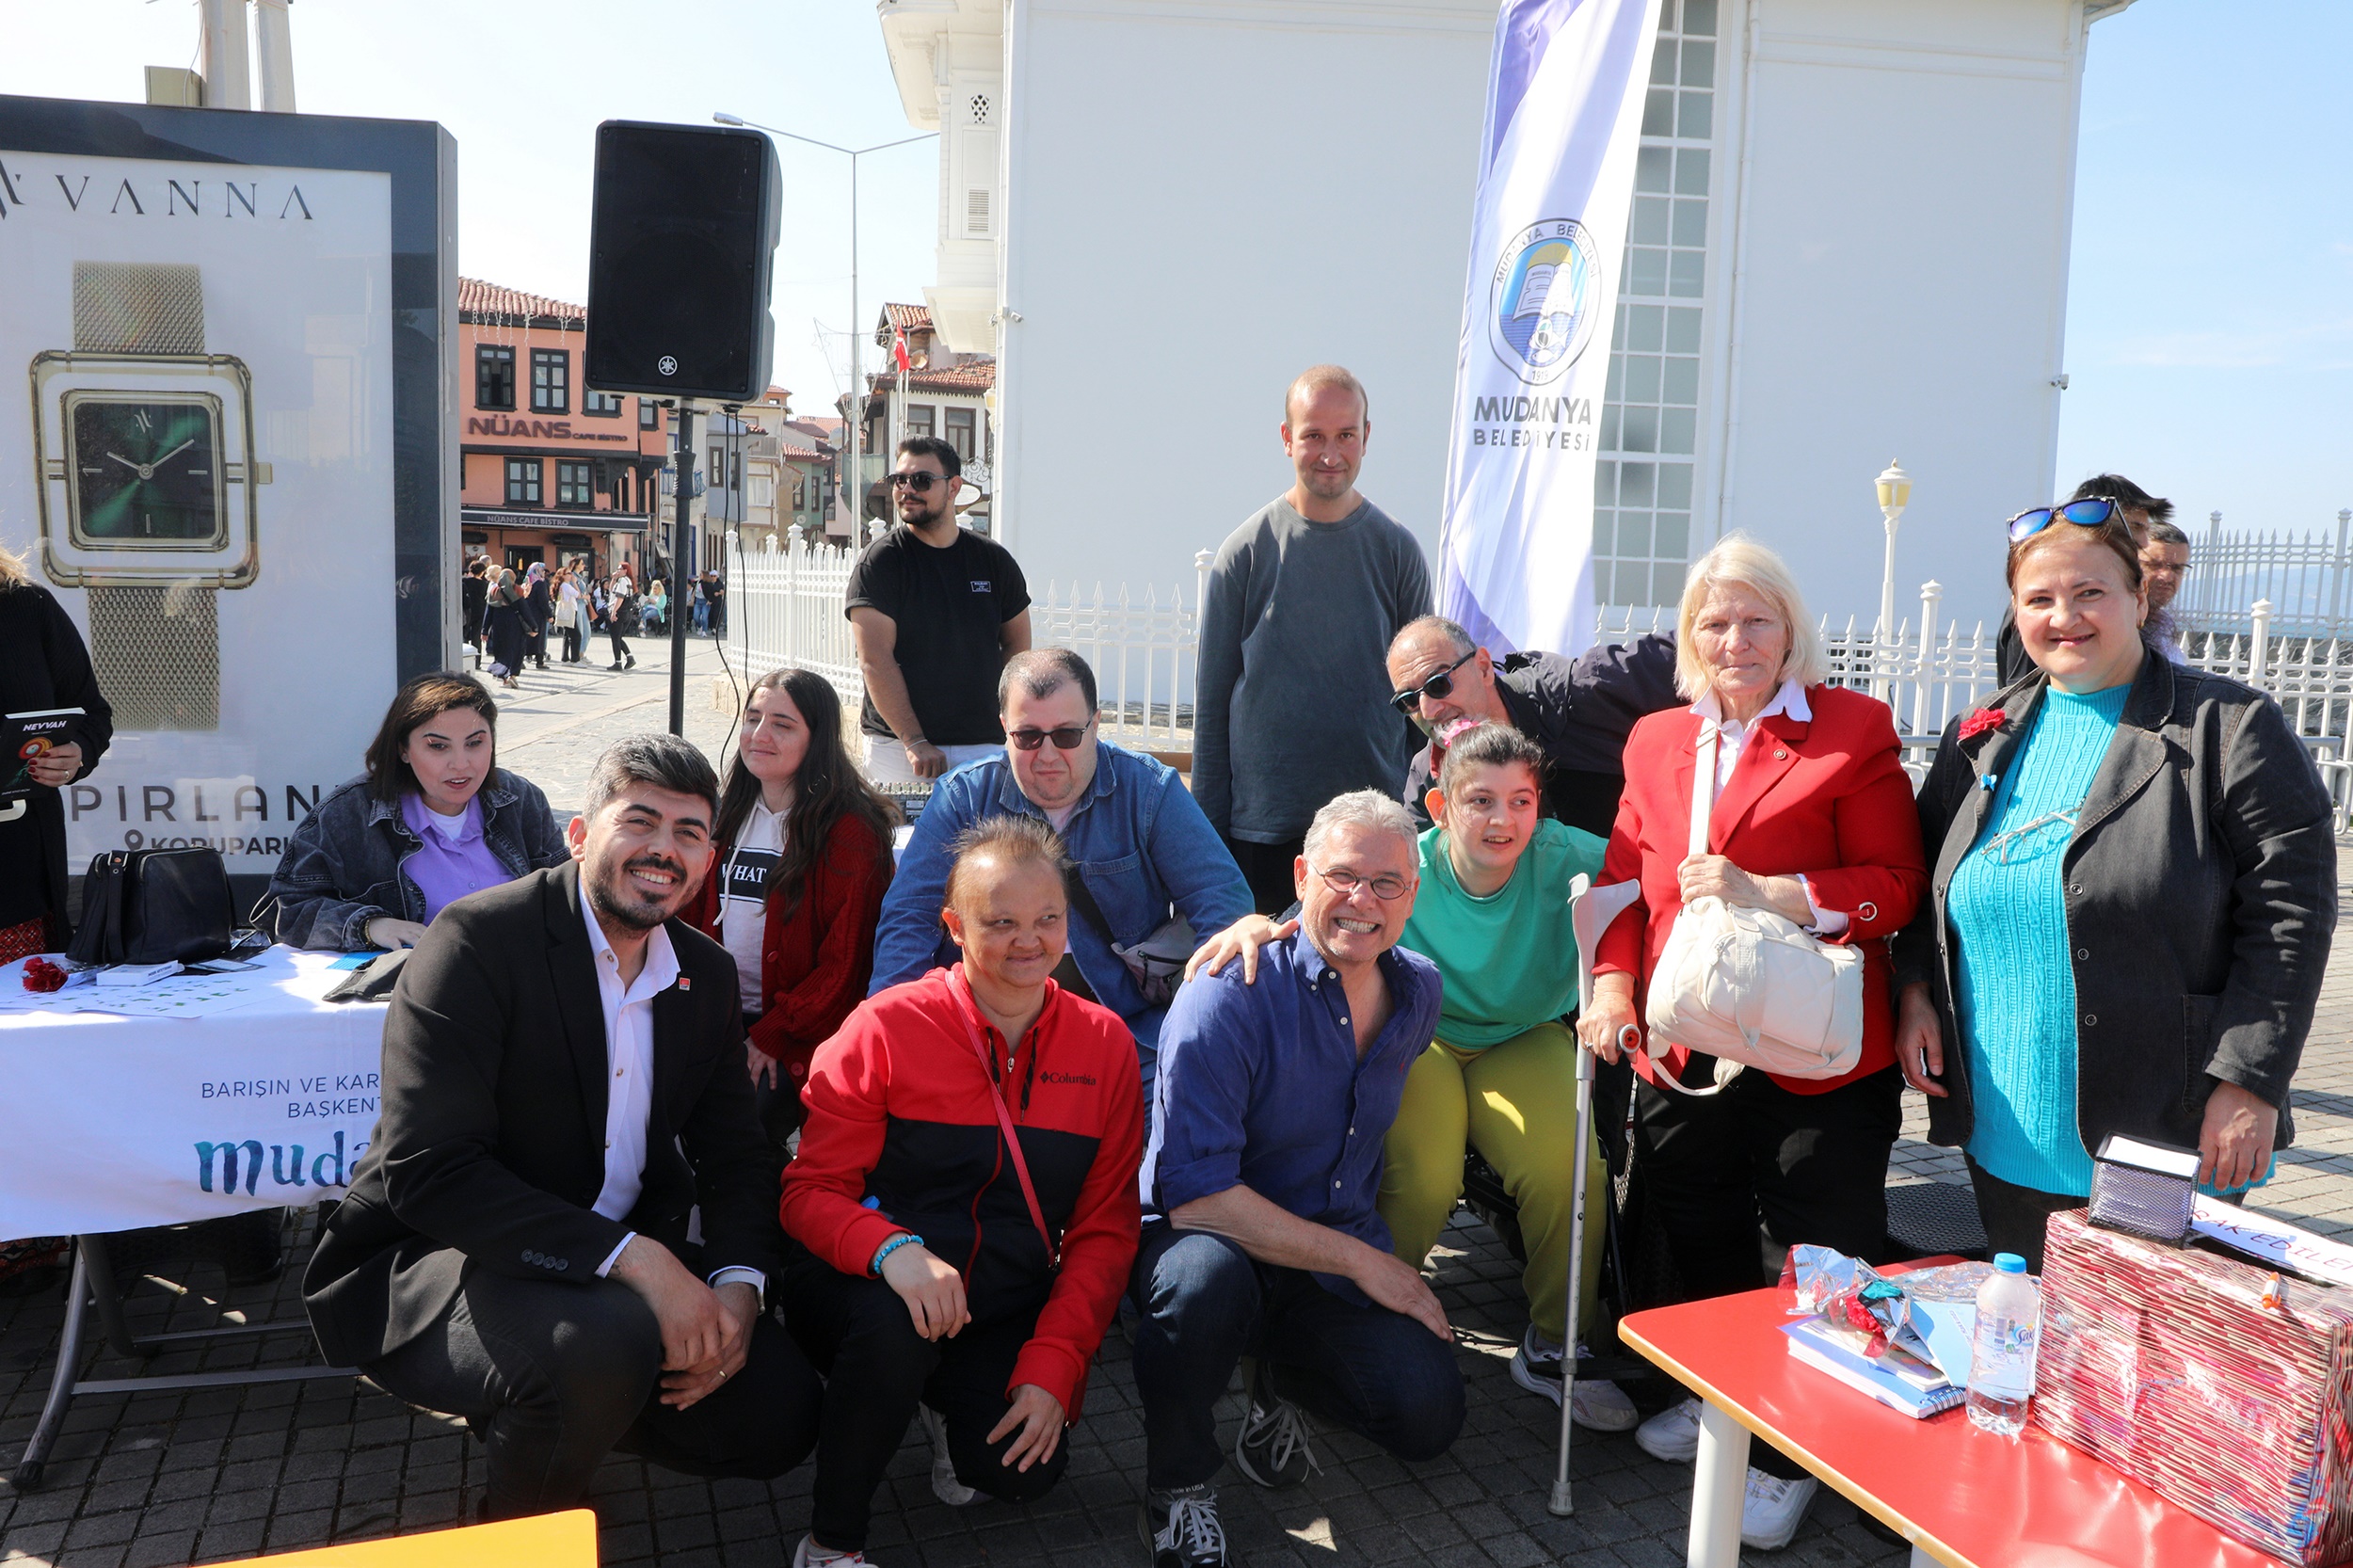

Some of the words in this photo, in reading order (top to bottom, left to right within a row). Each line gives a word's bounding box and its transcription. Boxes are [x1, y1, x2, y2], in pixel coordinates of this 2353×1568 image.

[1496, 226, 1545, 284] MUDANYA
[1531, 370, 1549, 381] 1919
[1473, 396, 1592, 425] MUDANYA
[468, 413, 572, 439] NÜANS
[1473, 428, 1591, 451] BELEDİYESİ
[487, 515, 518, 524] NÜANS
[519, 517, 539, 525] CAFE
[540, 517, 569, 526] BİSTRO
[23, 720, 68, 732] NEVVAH
[71, 784, 344, 823] PIRLAN
[721, 863, 767, 884] WHAT
[201, 1079, 290, 1099] BARIŞIN
[299, 1077, 328, 1094] VE
[1049, 1071, 1096, 1086] Columbia
[1192, 1482, 1206, 1492] USA
